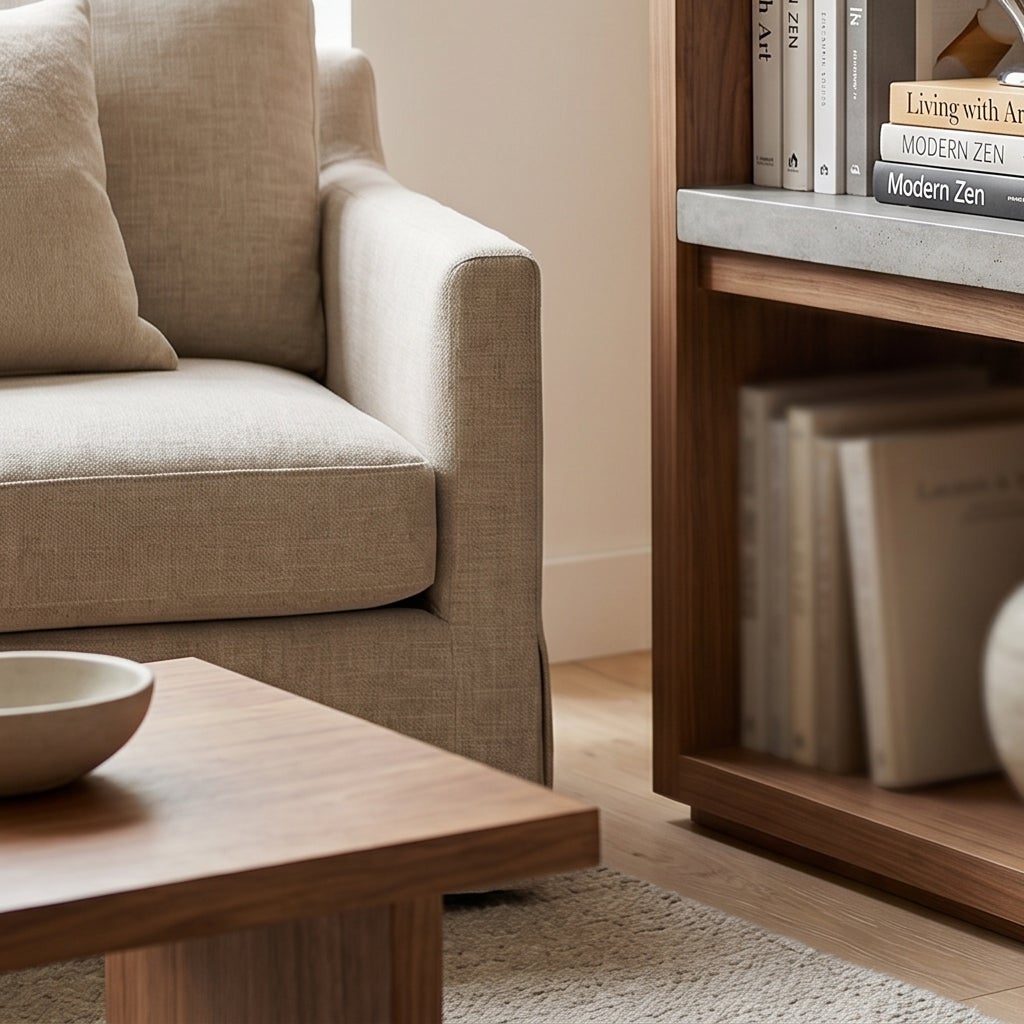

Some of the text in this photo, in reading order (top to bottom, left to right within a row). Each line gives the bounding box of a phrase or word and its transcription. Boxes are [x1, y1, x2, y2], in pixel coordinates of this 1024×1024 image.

[758, 24, 772, 62] Art
[788, 12, 799, 49] ZEN
[907, 92, 960, 125] Living
[963, 97, 999, 122] with
[902, 134, 968, 160] MODERN
[973, 141, 1005, 165] ZEN
[888, 172, 949, 201] Modern
[954, 179, 985, 206] Zen
